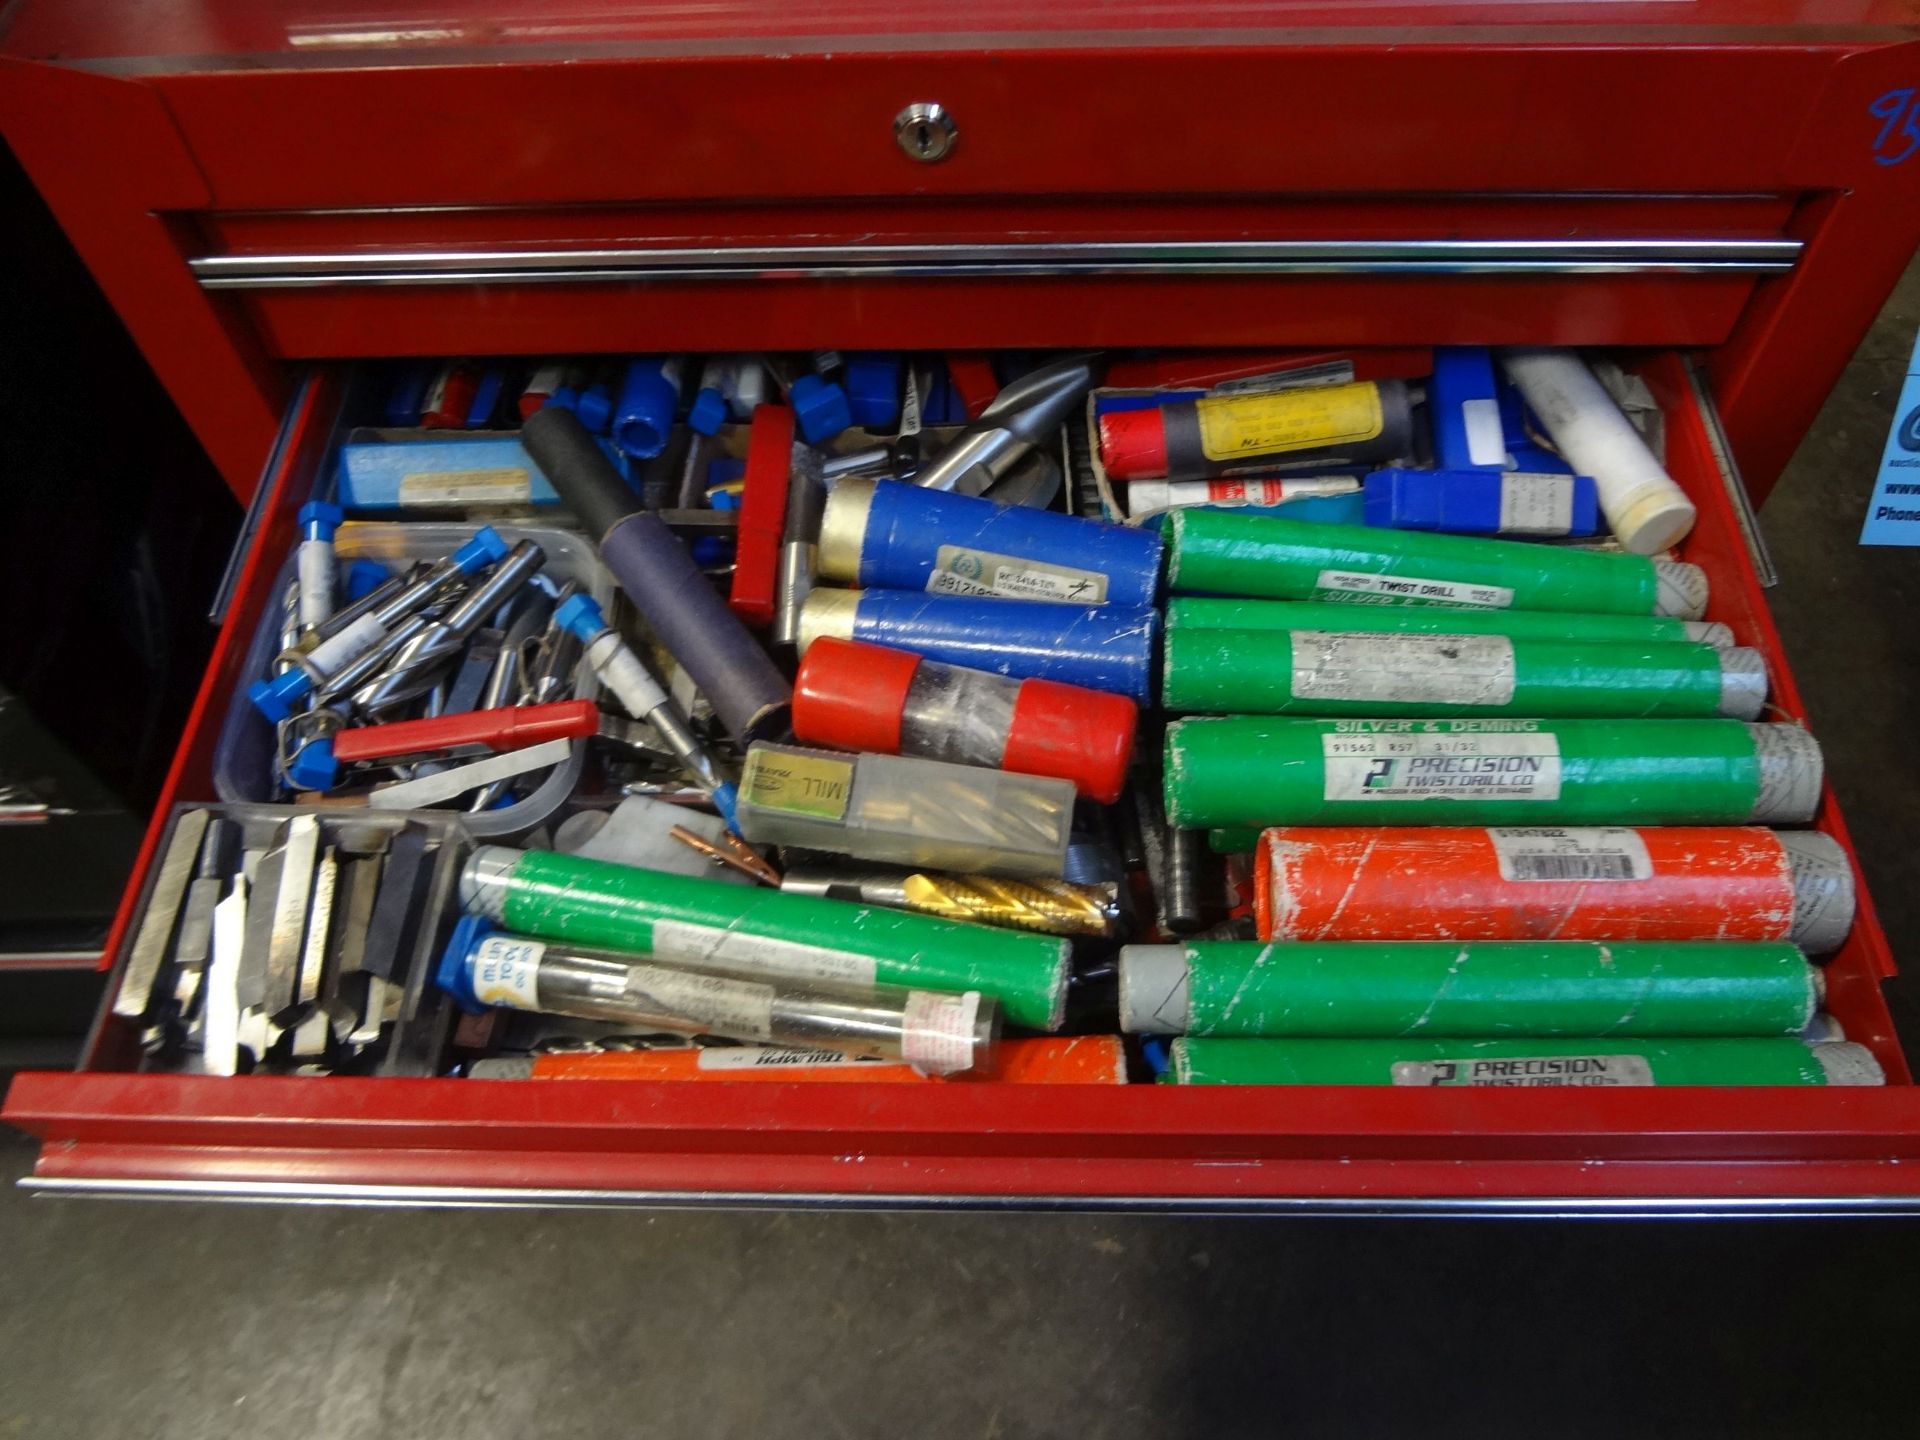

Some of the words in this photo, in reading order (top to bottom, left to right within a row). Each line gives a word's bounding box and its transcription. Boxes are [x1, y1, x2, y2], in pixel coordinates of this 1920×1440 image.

[1379, 580, 1416, 593] TWIST
[1421, 584, 1456, 597] DRILL
[1334, 721, 1413, 732] SILVER
[1422, 721, 1440, 732] &
[1450, 720, 1538, 732] DEMING
[1407, 757, 1543, 773] PRECISION
[803, 776, 843, 800] MILL
[1405, 774, 1458, 787] TWIST
[1459, 774, 1508, 787] DRILL
[755, 1053, 843, 1065] TRIUMPH
[1473, 1058, 1607, 1076] PRECISION
